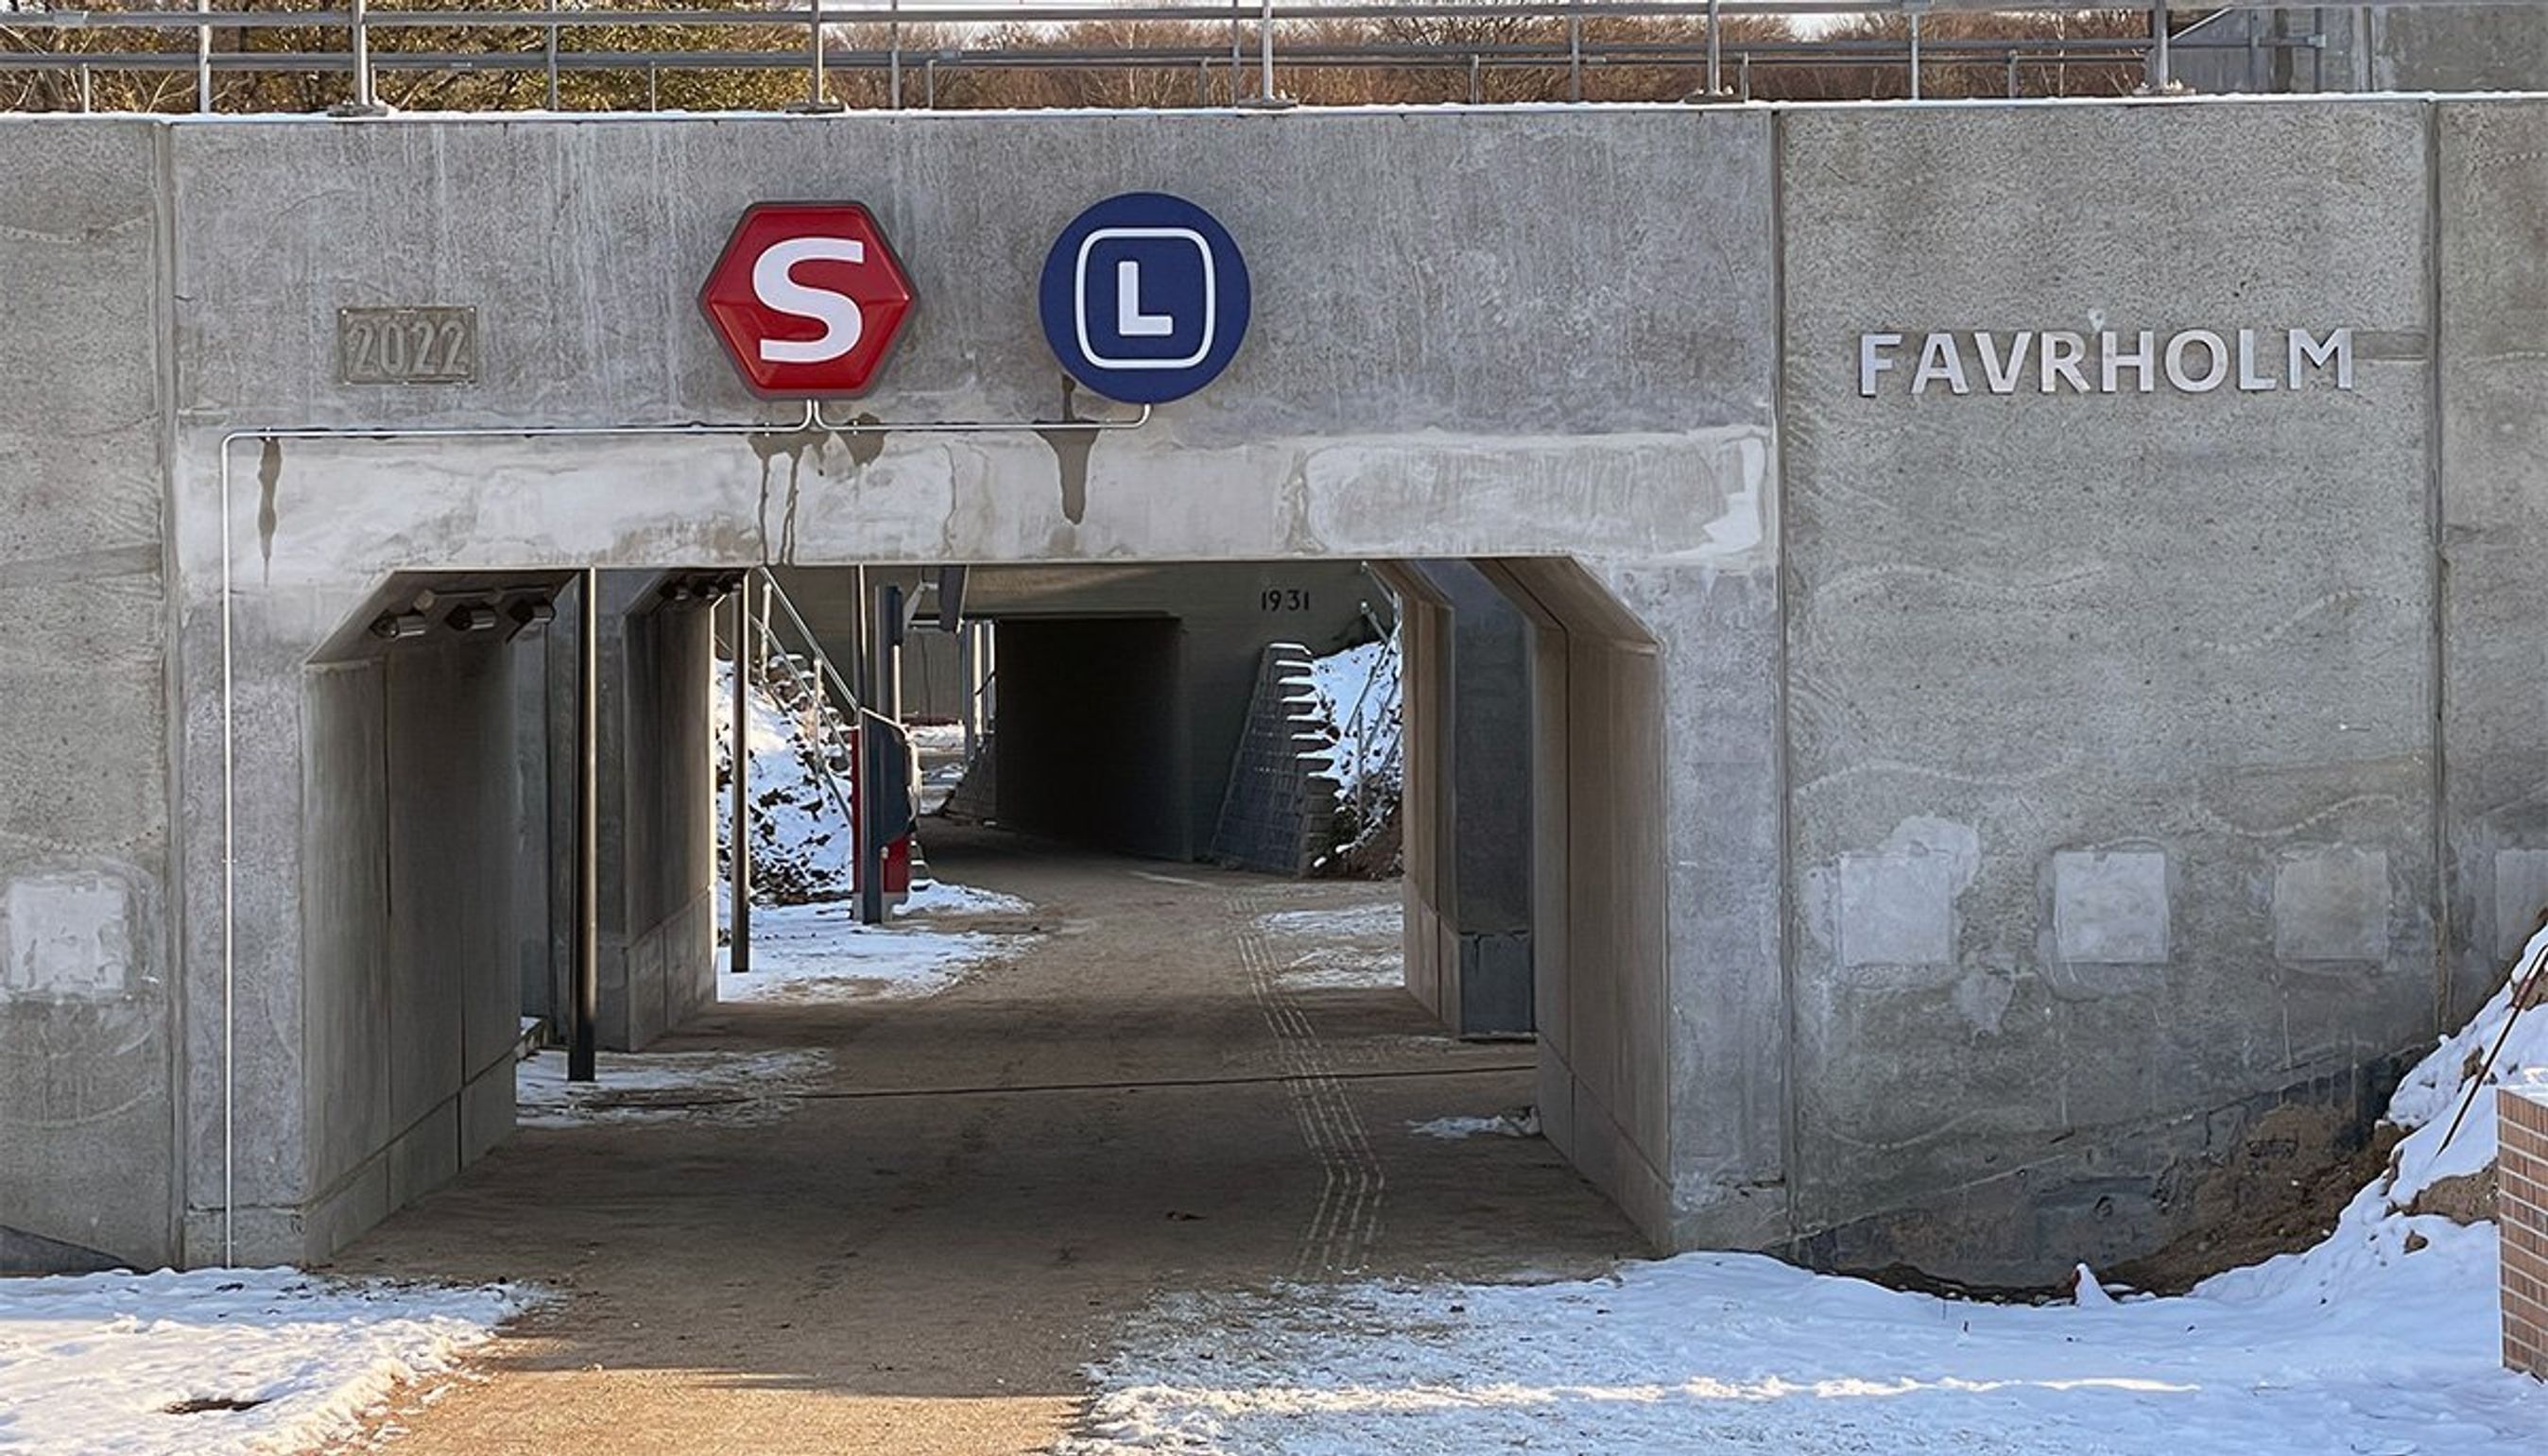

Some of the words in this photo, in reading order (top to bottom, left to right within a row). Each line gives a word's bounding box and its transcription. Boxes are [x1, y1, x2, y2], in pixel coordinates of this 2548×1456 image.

[753, 236, 864, 362] S
[1118, 260, 1173, 335] L
[347, 318, 470, 376] 2022
[1859, 328, 2353, 397] FAVRHOLM
[1262, 590, 1310, 612] 1931
